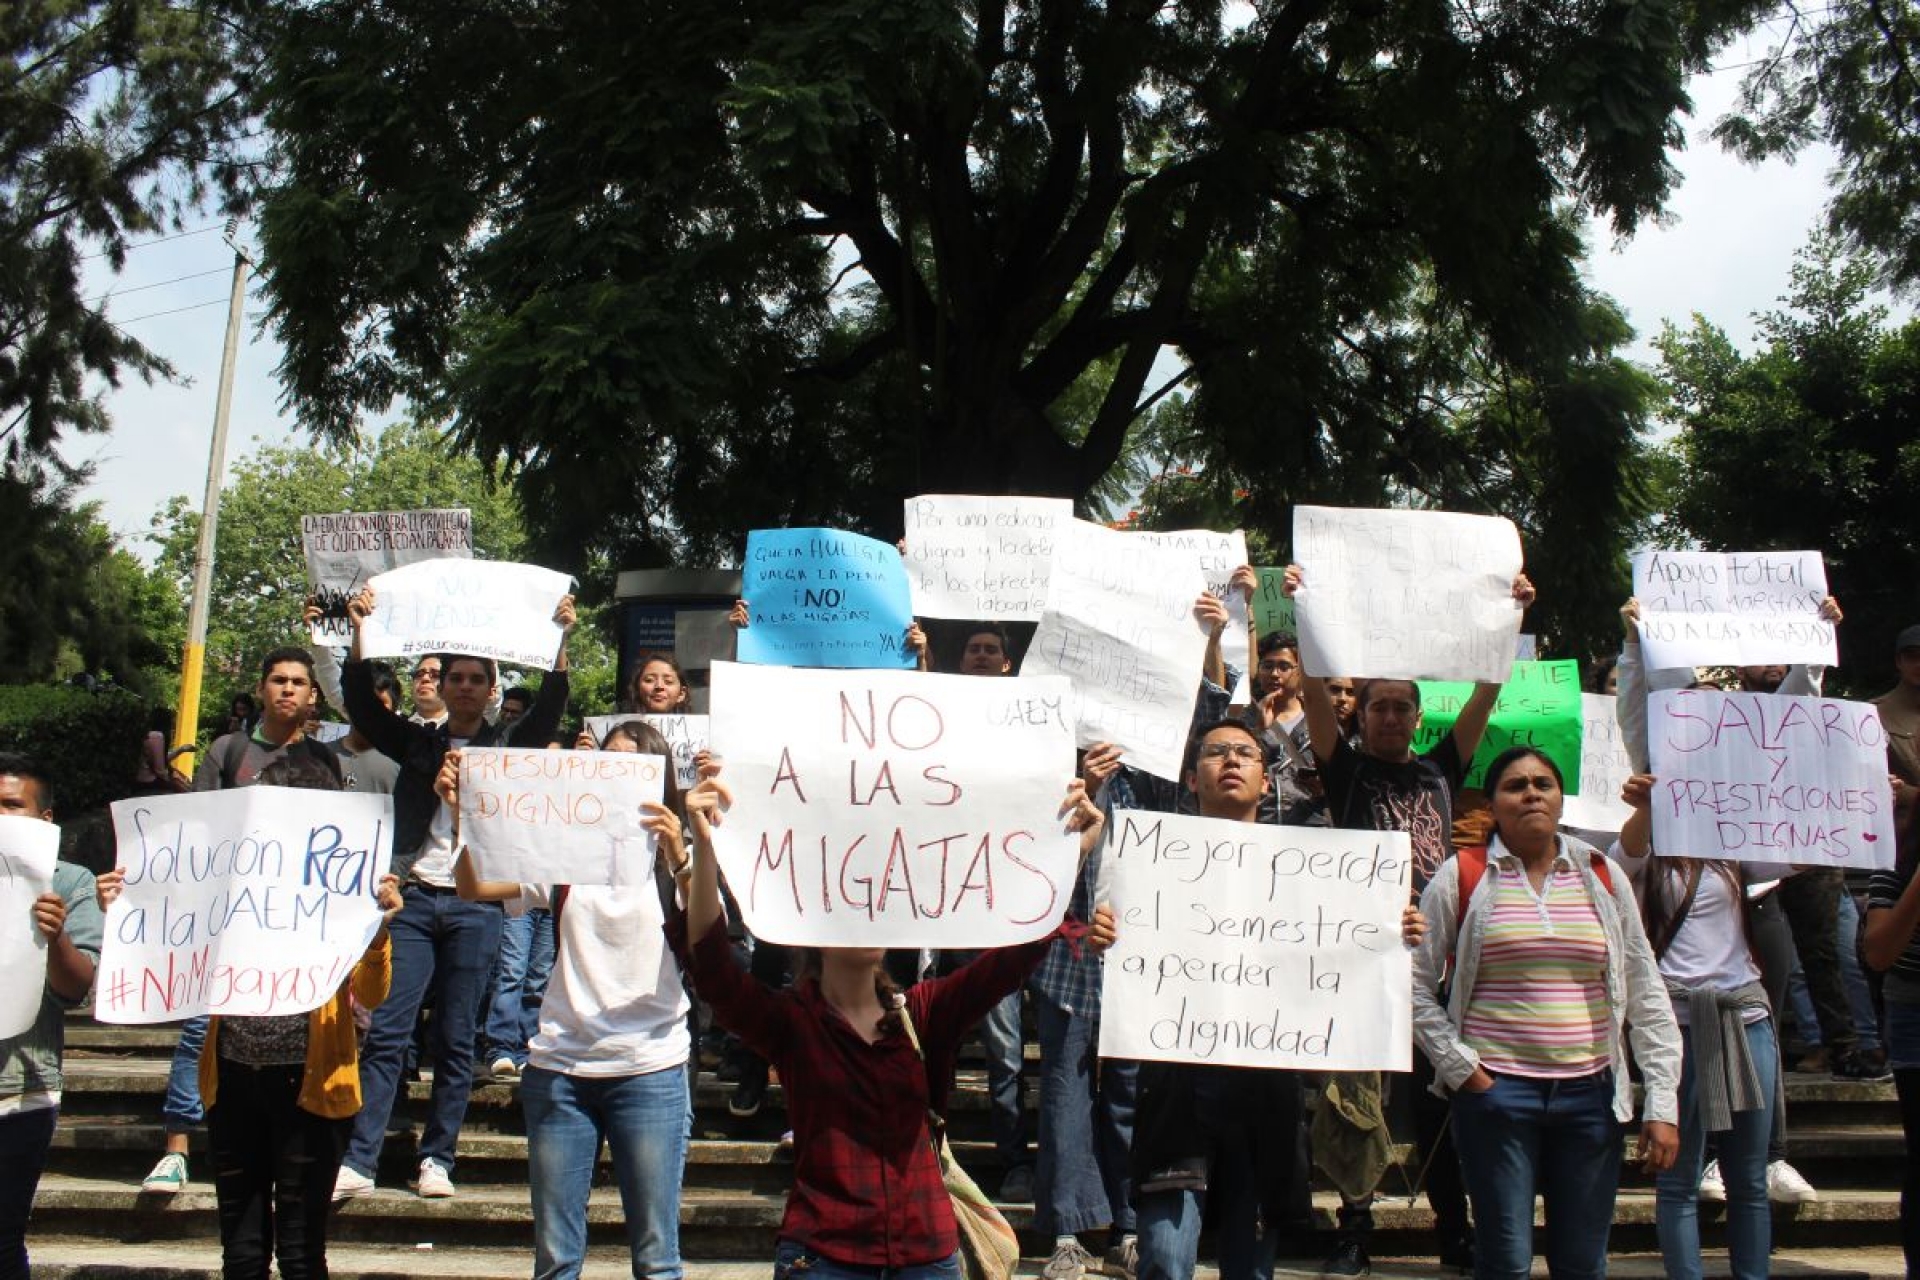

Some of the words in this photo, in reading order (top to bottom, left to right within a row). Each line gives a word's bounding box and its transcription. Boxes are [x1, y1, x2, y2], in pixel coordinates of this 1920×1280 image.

[956, 512, 988, 527] una
[314, 534, 329, 551] DE
[332, 532, 382, 552] QUIENES
[978, 546, 991, 563] y
[1206, 537, 1231, 551] LA
[759, 569, 807, 582] VALGA
[818, 569, 838, 581] LA
[1647, 553, 1719, 596] Apoyo
[1727, 556, 1804, 587] total
[756, 614, 766, 625] A
[770, 612, 796, 624] LAS
[804, 610, 870, 624] MIGAJAS
[1649, 596, 1669, 613] a
[1644, 620, 1676, 642] NO
[1705, 620, 1741, 641] LAS
[837, 688, 946, 752] NO
[986, 696, 1070, 733] UAEM
[1664, 690, 1882, 753] SALARIO
[464, 752, 660, 785] PRESUPUESTO
[770, 746, 807, 804] A
[849, 759, 963, 806] LAS
[1766, 755, 1789, 783] Y
[475, 791, 605, 825] DIGNO
[1666, 778, 1879, 818] PRESTACIONES
[1716, 819, 1851, 858] DIGNAS
[303, 818, 382, 900] Real
[750, 826, 1057, 925] MIGAJAS
[1117, 817, 1256, 884] Mejor
[1268, 843, 1411, 902] perder
[118, 906, 146, 946] a
[162, 895, 195, 947] la
[1124, 890, 1161, 931] el
[1308, 954, 1341, 994] la
[1149, 996, 1335, 1059] dignidad
